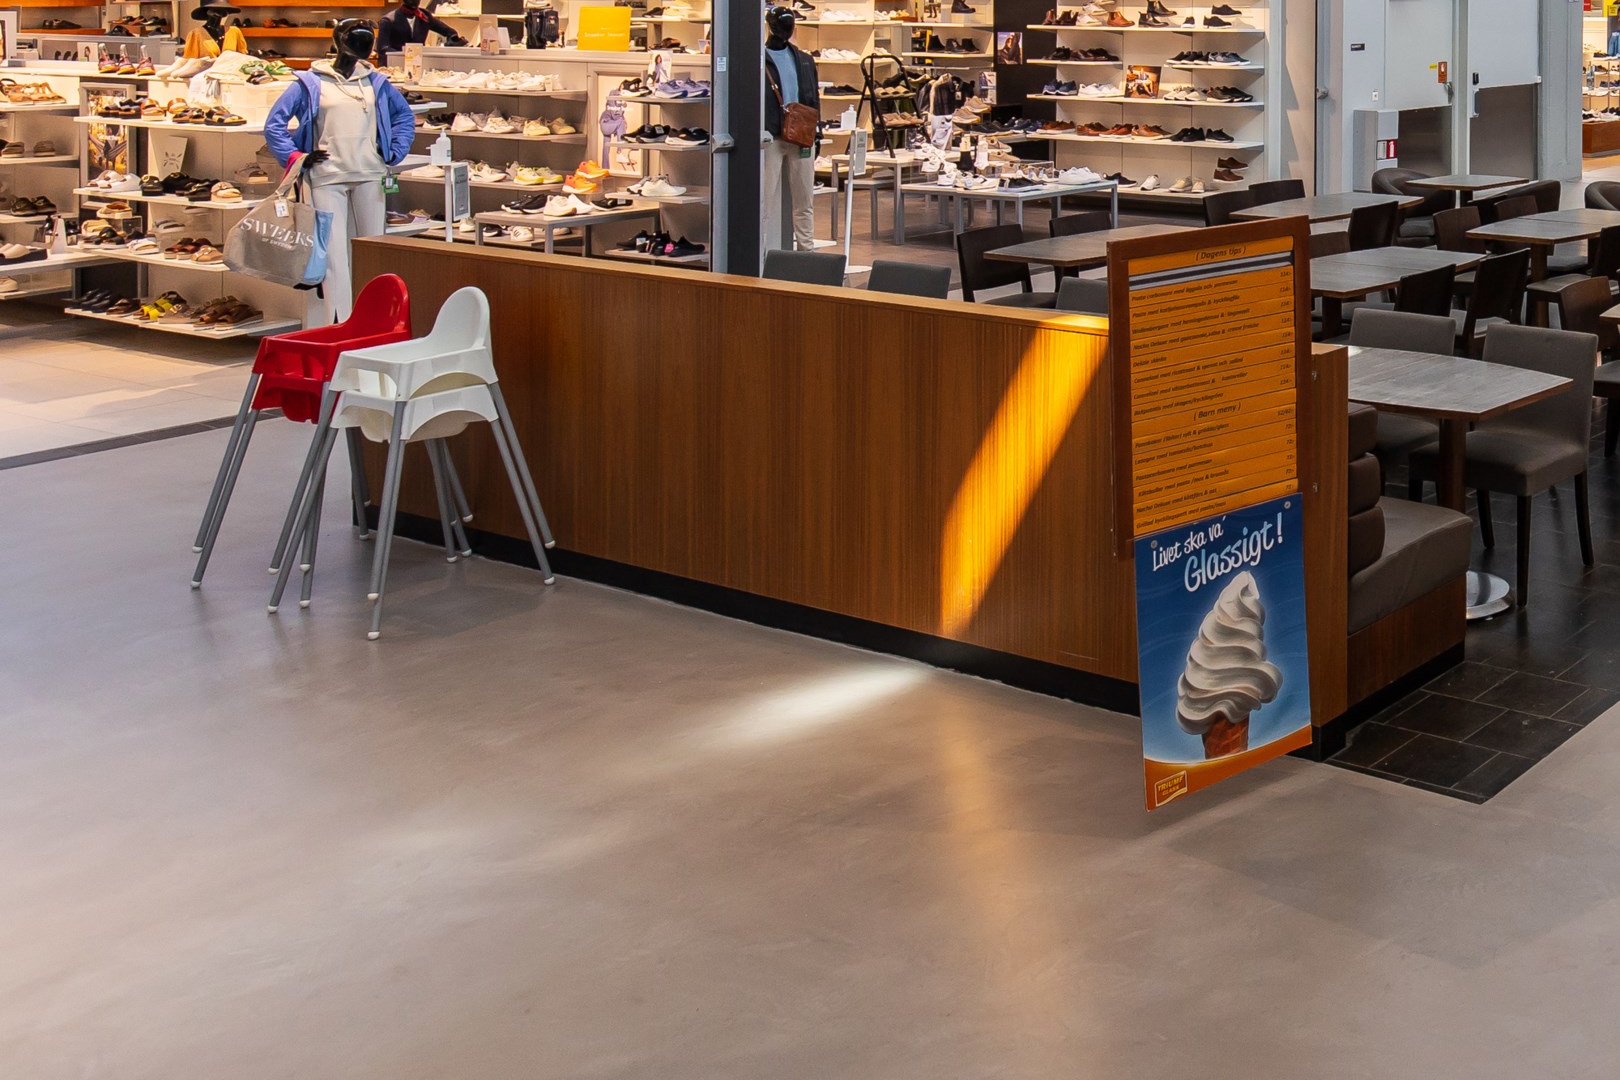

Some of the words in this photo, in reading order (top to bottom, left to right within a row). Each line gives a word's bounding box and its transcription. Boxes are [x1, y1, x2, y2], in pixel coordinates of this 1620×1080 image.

[240, 217, 314, 247] SWEEKS
[1200, 249, 1227, 260] Dagens
[1229, 246, 1242, 256] tips
[1198, 408, 1214, 419] Barn
[1217, 403, 1236, 415] meny
[1152, 543, 1182, 572] Livet
[1184, 532, 1207, 554] ska
[1158, 775, 1184, 793] TRIUMF
